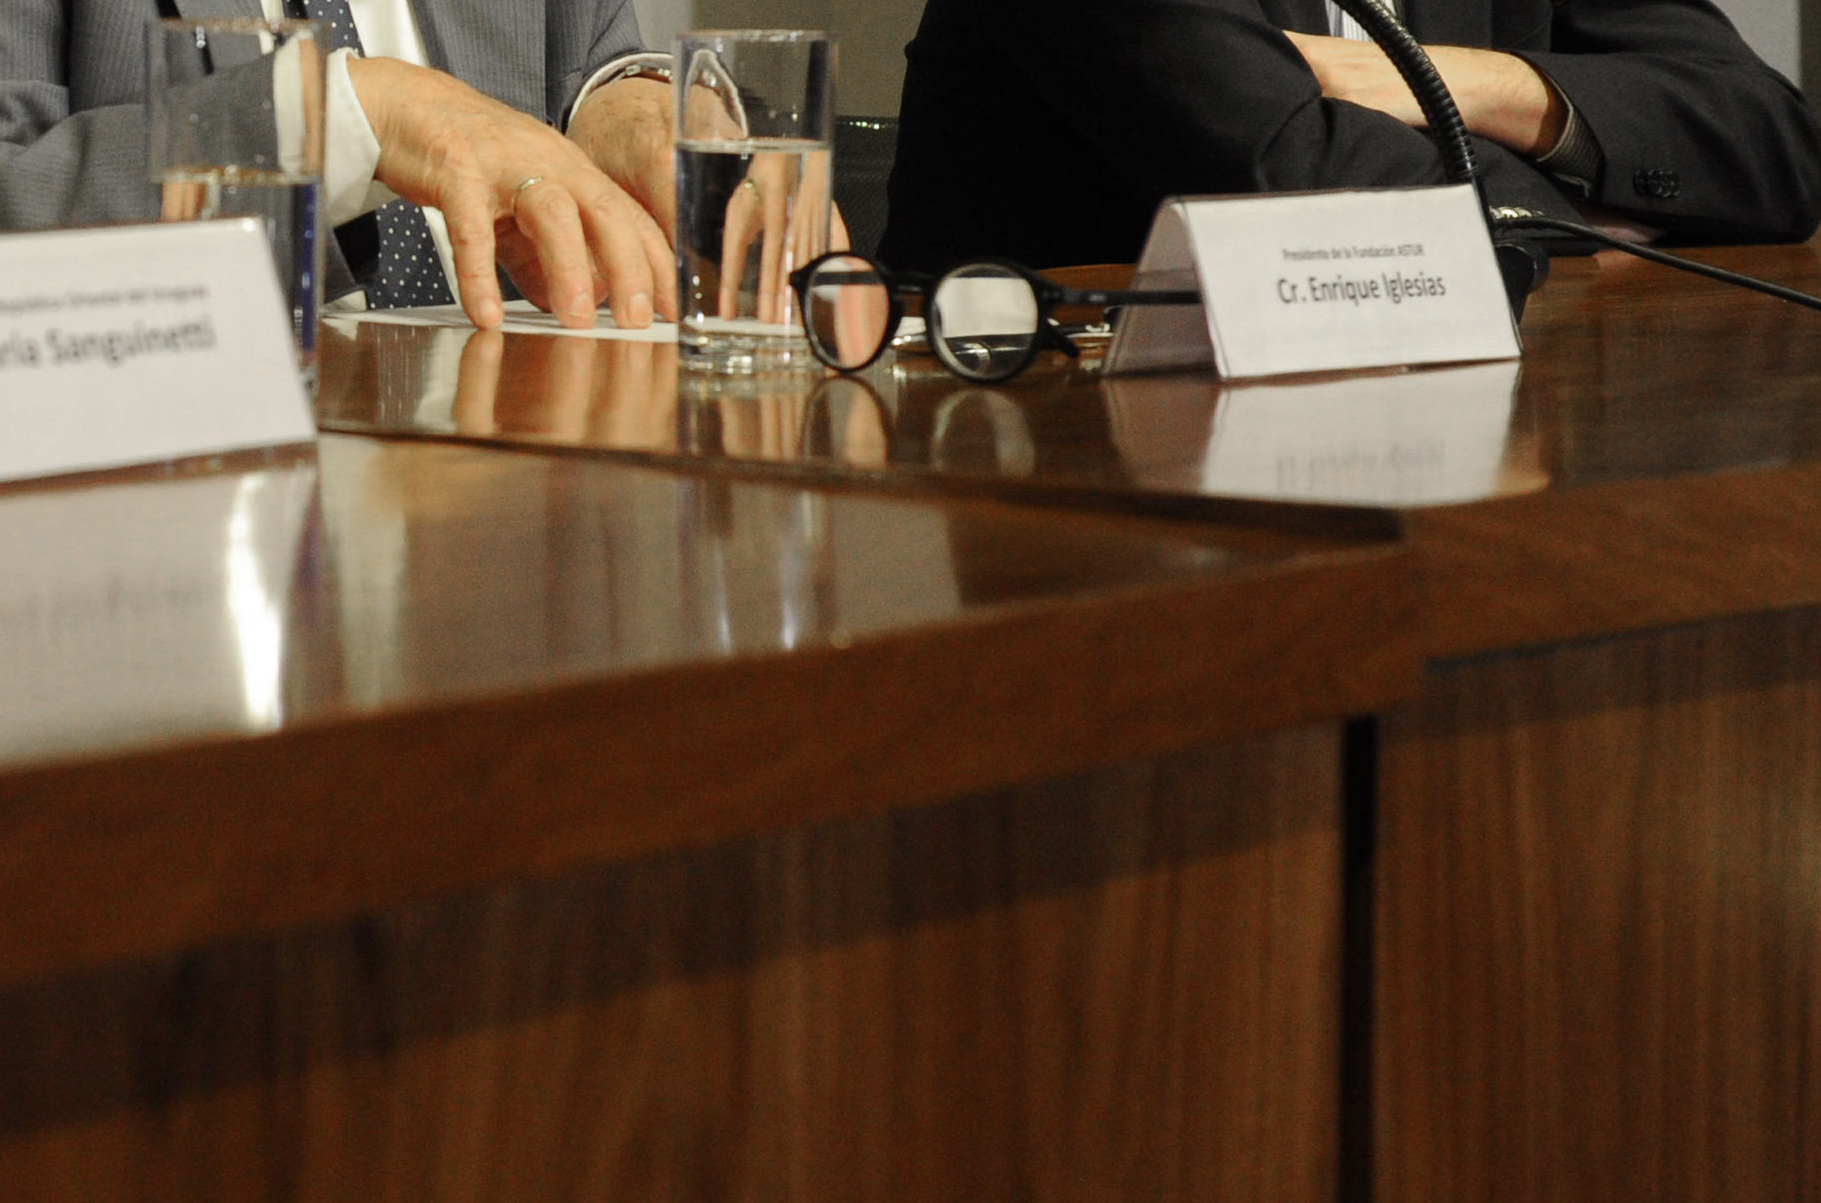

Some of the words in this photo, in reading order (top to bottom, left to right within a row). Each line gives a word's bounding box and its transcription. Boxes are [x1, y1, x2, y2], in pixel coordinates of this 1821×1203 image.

[1277, 278, 1307, 304] Cr.
[1308, 274, 1381, 307] Enrique
[1381, 271, 1447, 305] Iglesias
[45, 314, 217, 368] Sanguinetti
